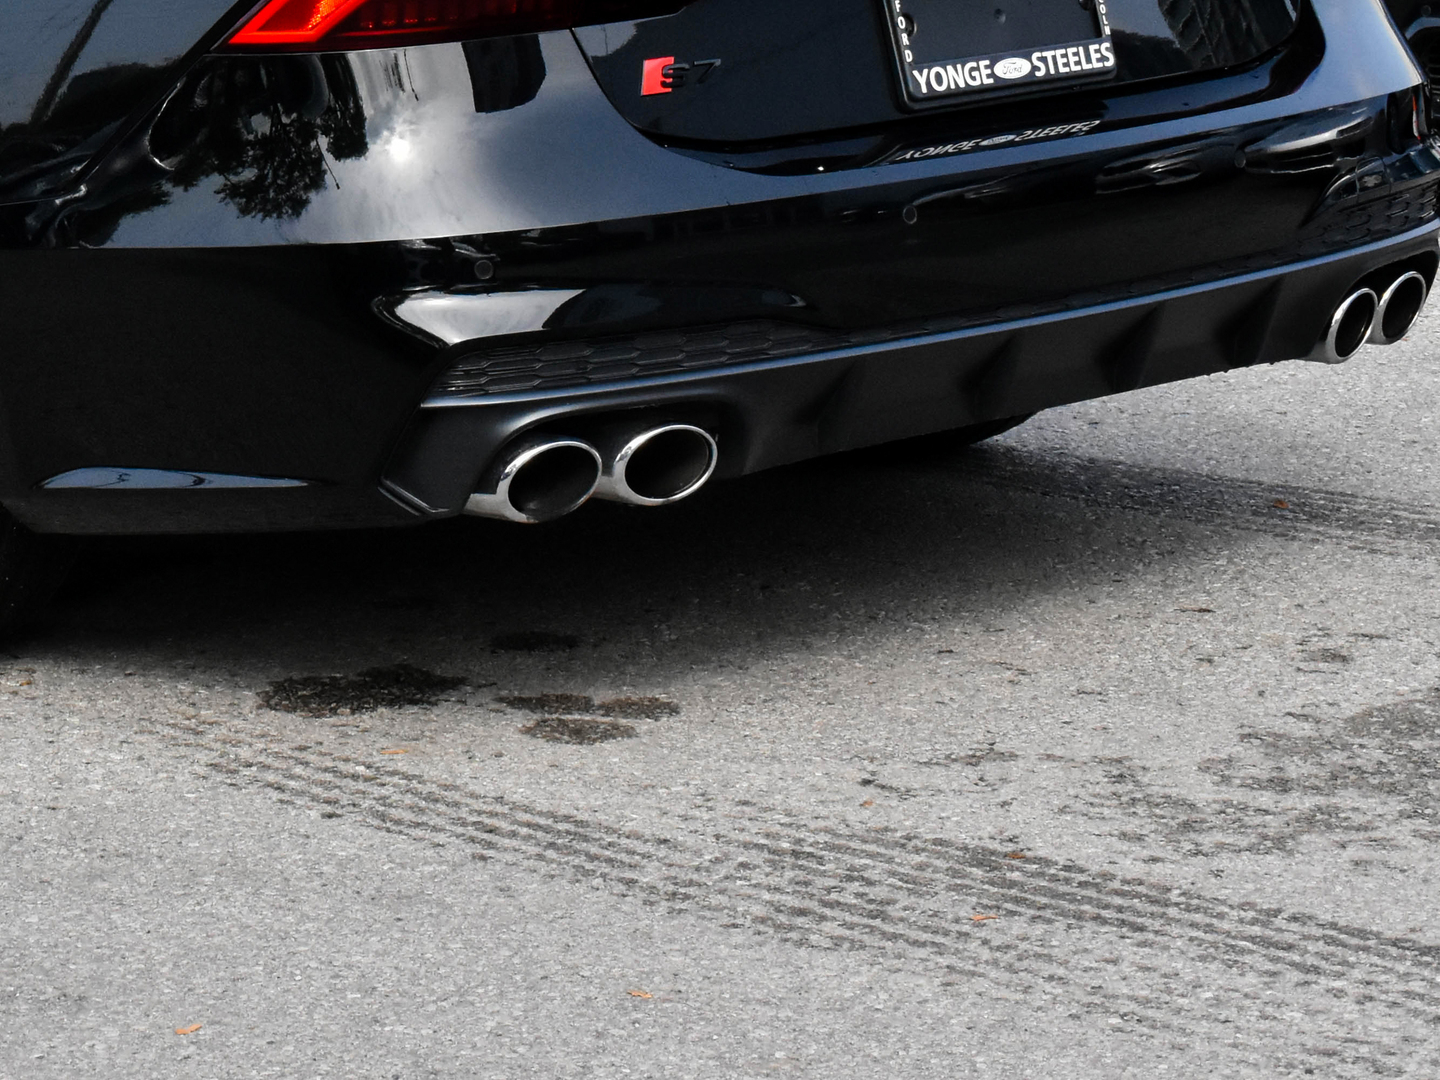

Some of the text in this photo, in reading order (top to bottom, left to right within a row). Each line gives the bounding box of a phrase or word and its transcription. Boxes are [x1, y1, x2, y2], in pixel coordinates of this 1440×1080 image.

[894, 0, 913, 63] FORD
[659, 58, 722, 89] S7
[912, 59, 995, 94] YONGE
[1031, 42, 1115, 77] STEELES
